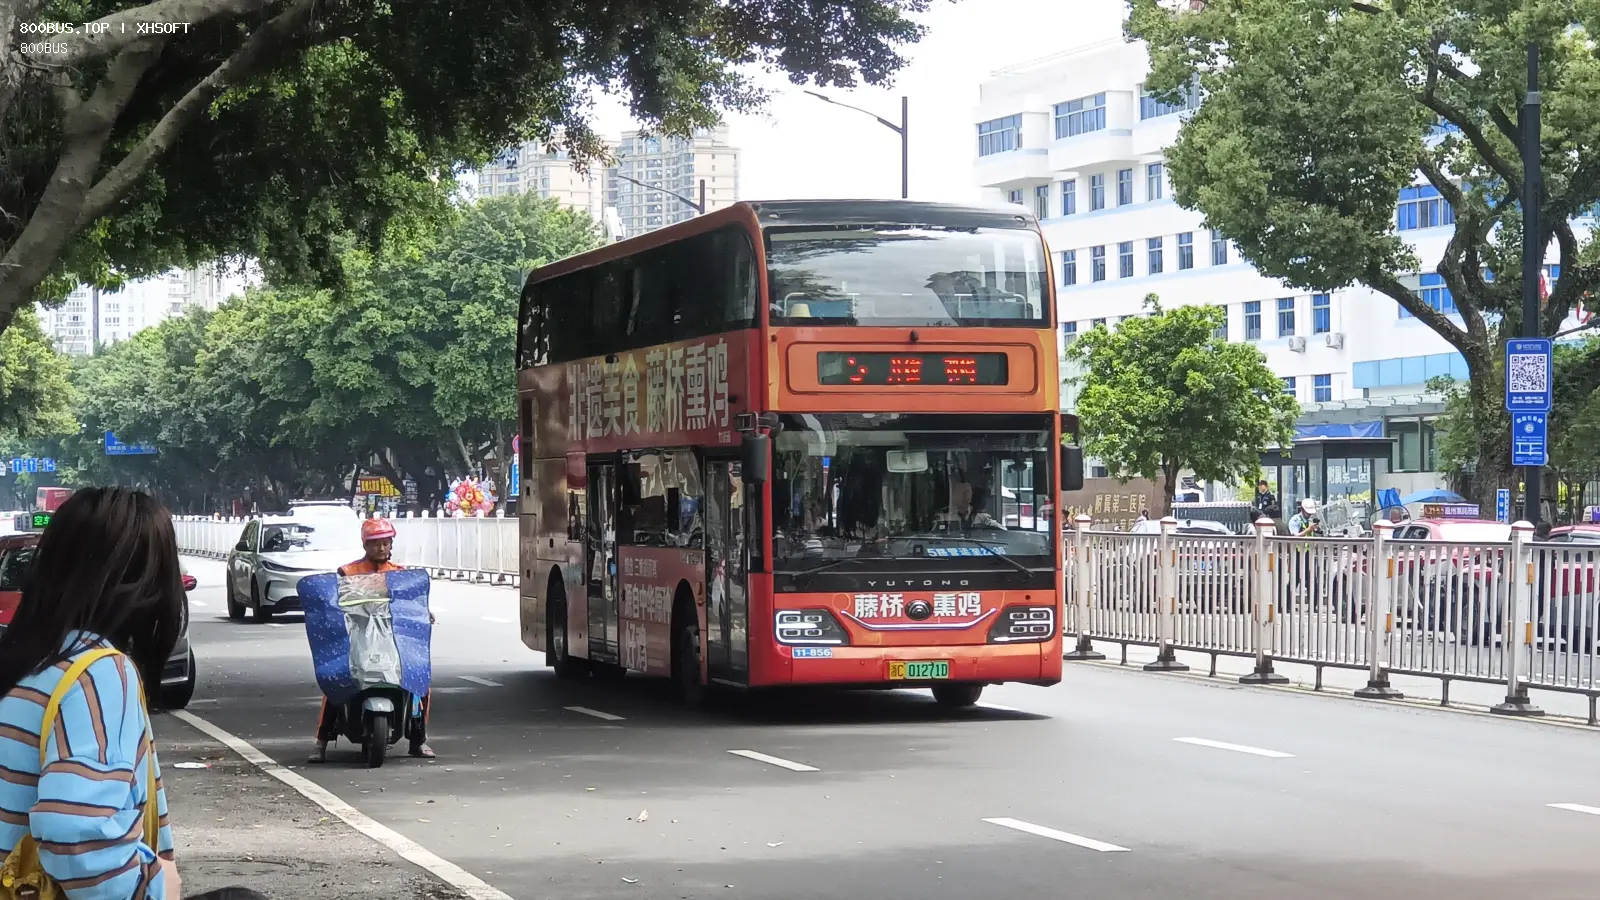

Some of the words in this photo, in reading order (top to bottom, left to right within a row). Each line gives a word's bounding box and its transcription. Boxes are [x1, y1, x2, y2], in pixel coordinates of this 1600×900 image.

[645, 338, 729, 433] 藤桥熏鸡
[867, 579, 969, 587] YUTONG
[854, 593, 904, 618] 藤桥
[933, 592, 982, 617] 熏鸡
[794, 648, 831, 657] 11-856
